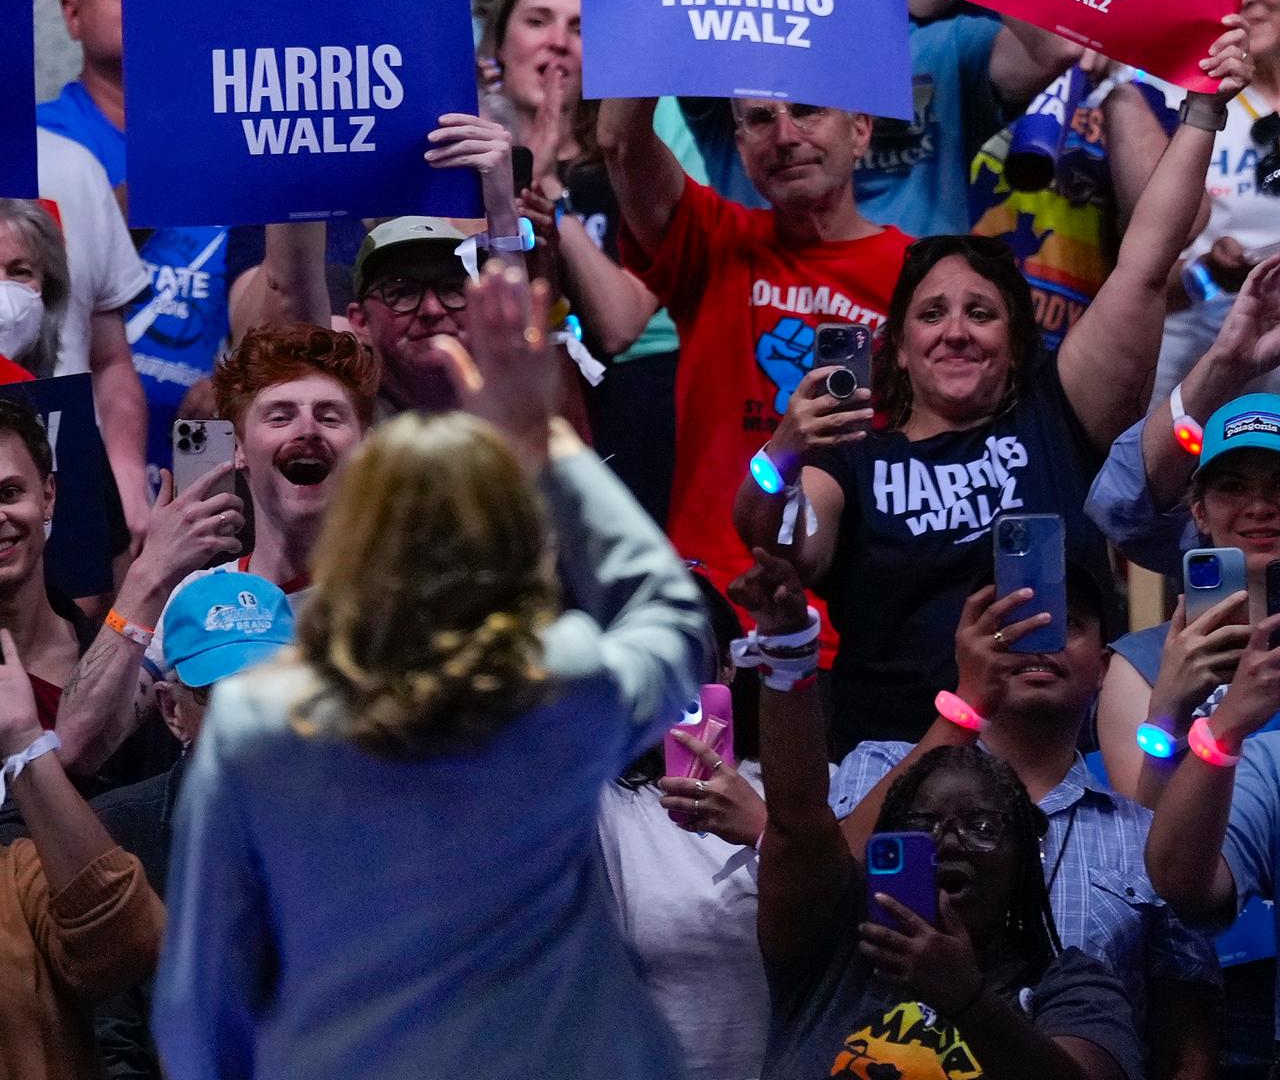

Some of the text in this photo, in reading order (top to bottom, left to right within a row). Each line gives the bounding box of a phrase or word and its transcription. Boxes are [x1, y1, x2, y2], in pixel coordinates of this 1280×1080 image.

[687, 9, 812, 50] WALZ
[211, 43, 405, 114] HARRIS
[241, 115, 377, 156] WALZ
[1226, 423, 1278, 438] patagonia
[872, 435, 1028, 515] HARRIS
[905, 476, 1024, 537] WALZ
